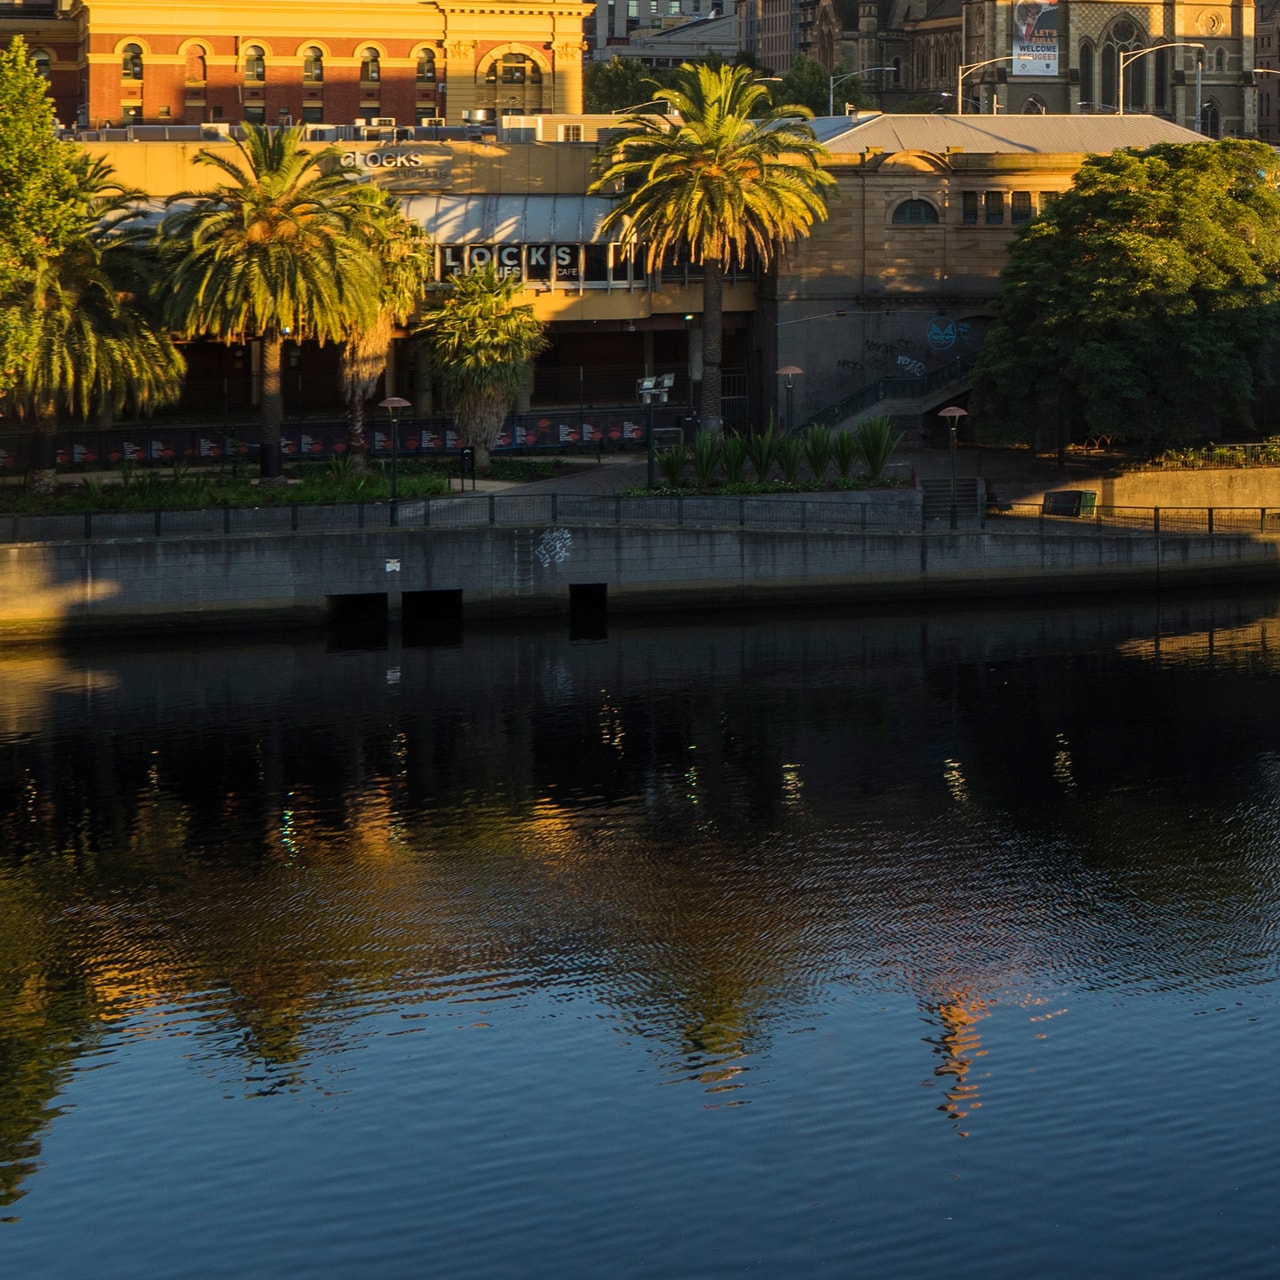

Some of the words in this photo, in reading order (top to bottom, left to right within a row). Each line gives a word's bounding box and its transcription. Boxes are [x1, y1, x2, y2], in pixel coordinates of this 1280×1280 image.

[1035, 29, 1057, 37] LET'S
[340, 151, 423, 169] CLOCKS
[557, 268, 578, 276] CAFE
